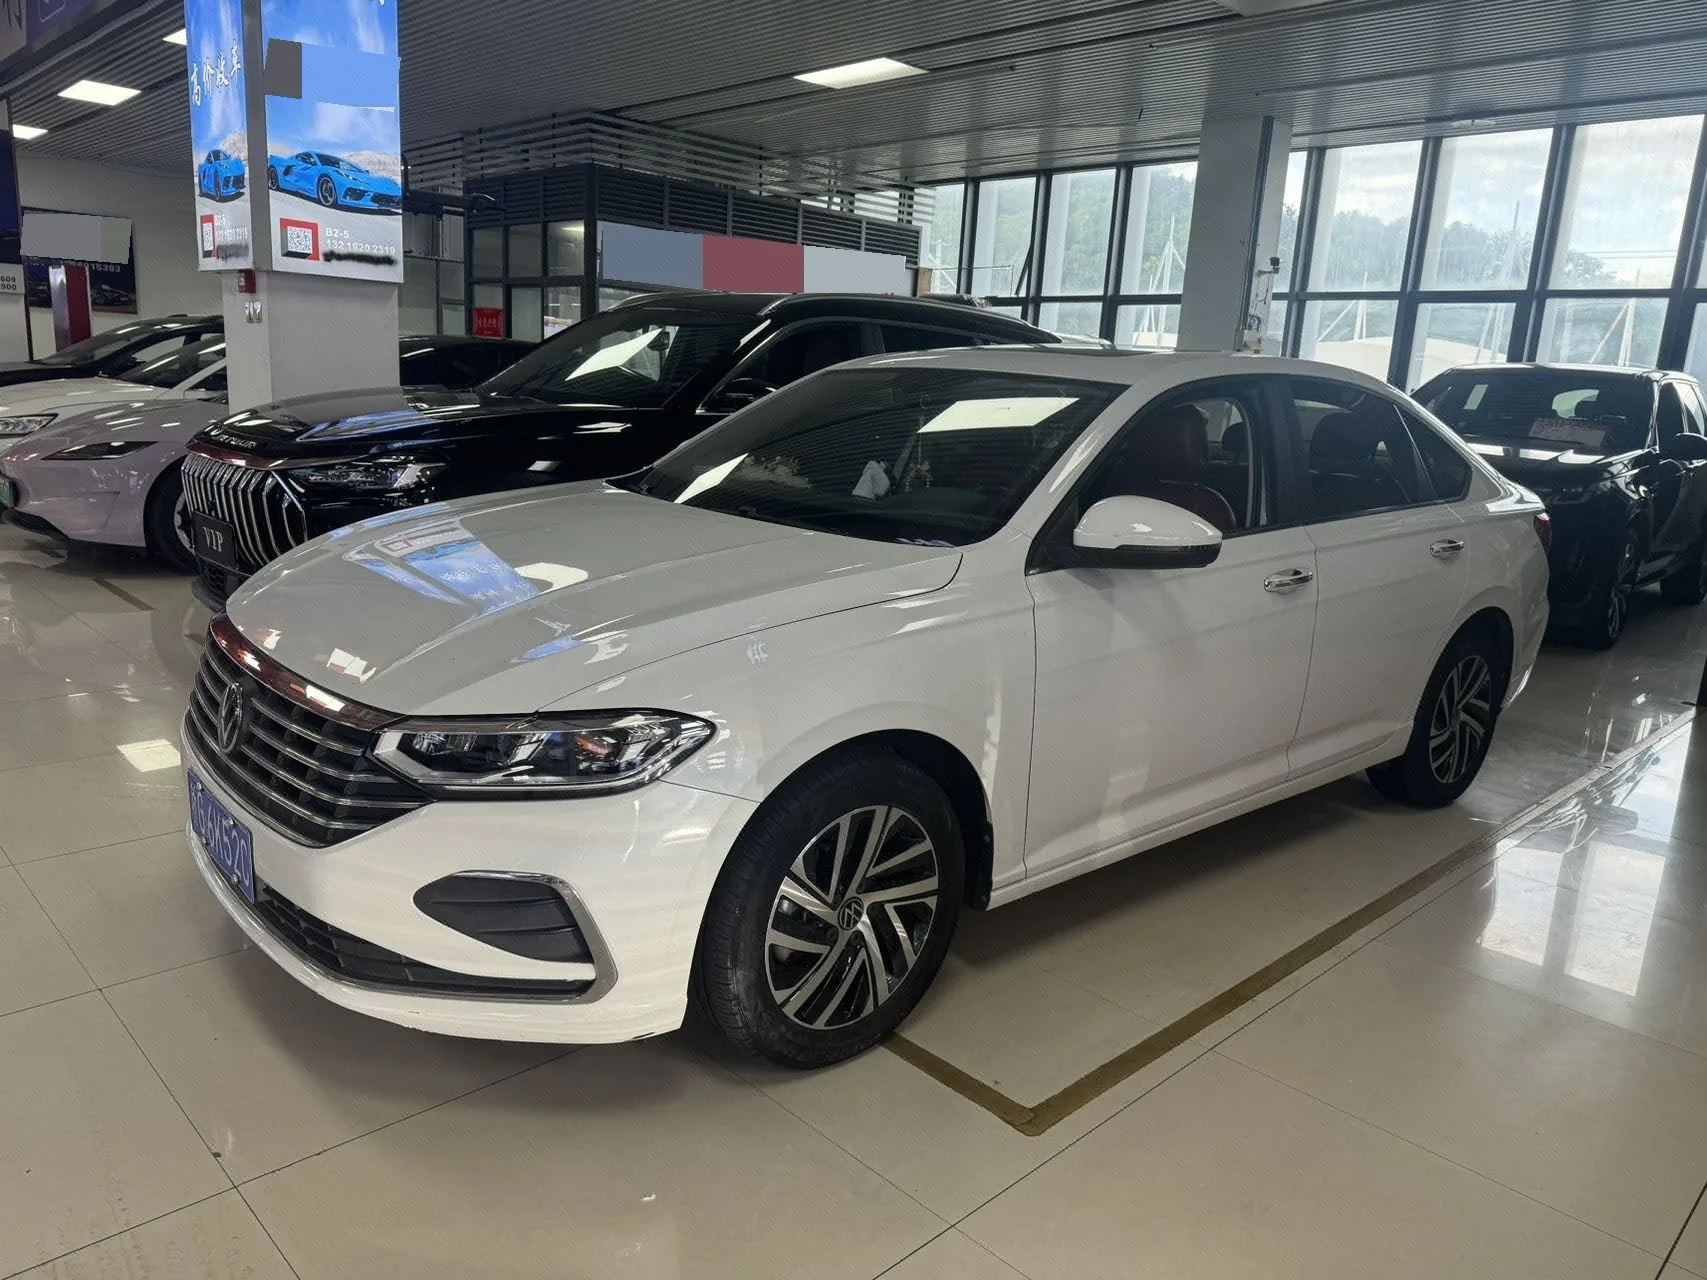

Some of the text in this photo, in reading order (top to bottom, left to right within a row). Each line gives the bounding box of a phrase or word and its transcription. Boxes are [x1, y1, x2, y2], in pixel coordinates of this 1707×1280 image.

[325, 227, 349, 239] B2-5
[326, 239, 396, 255] 132 1620 2319
[203, 527, 223, 553] VIP
